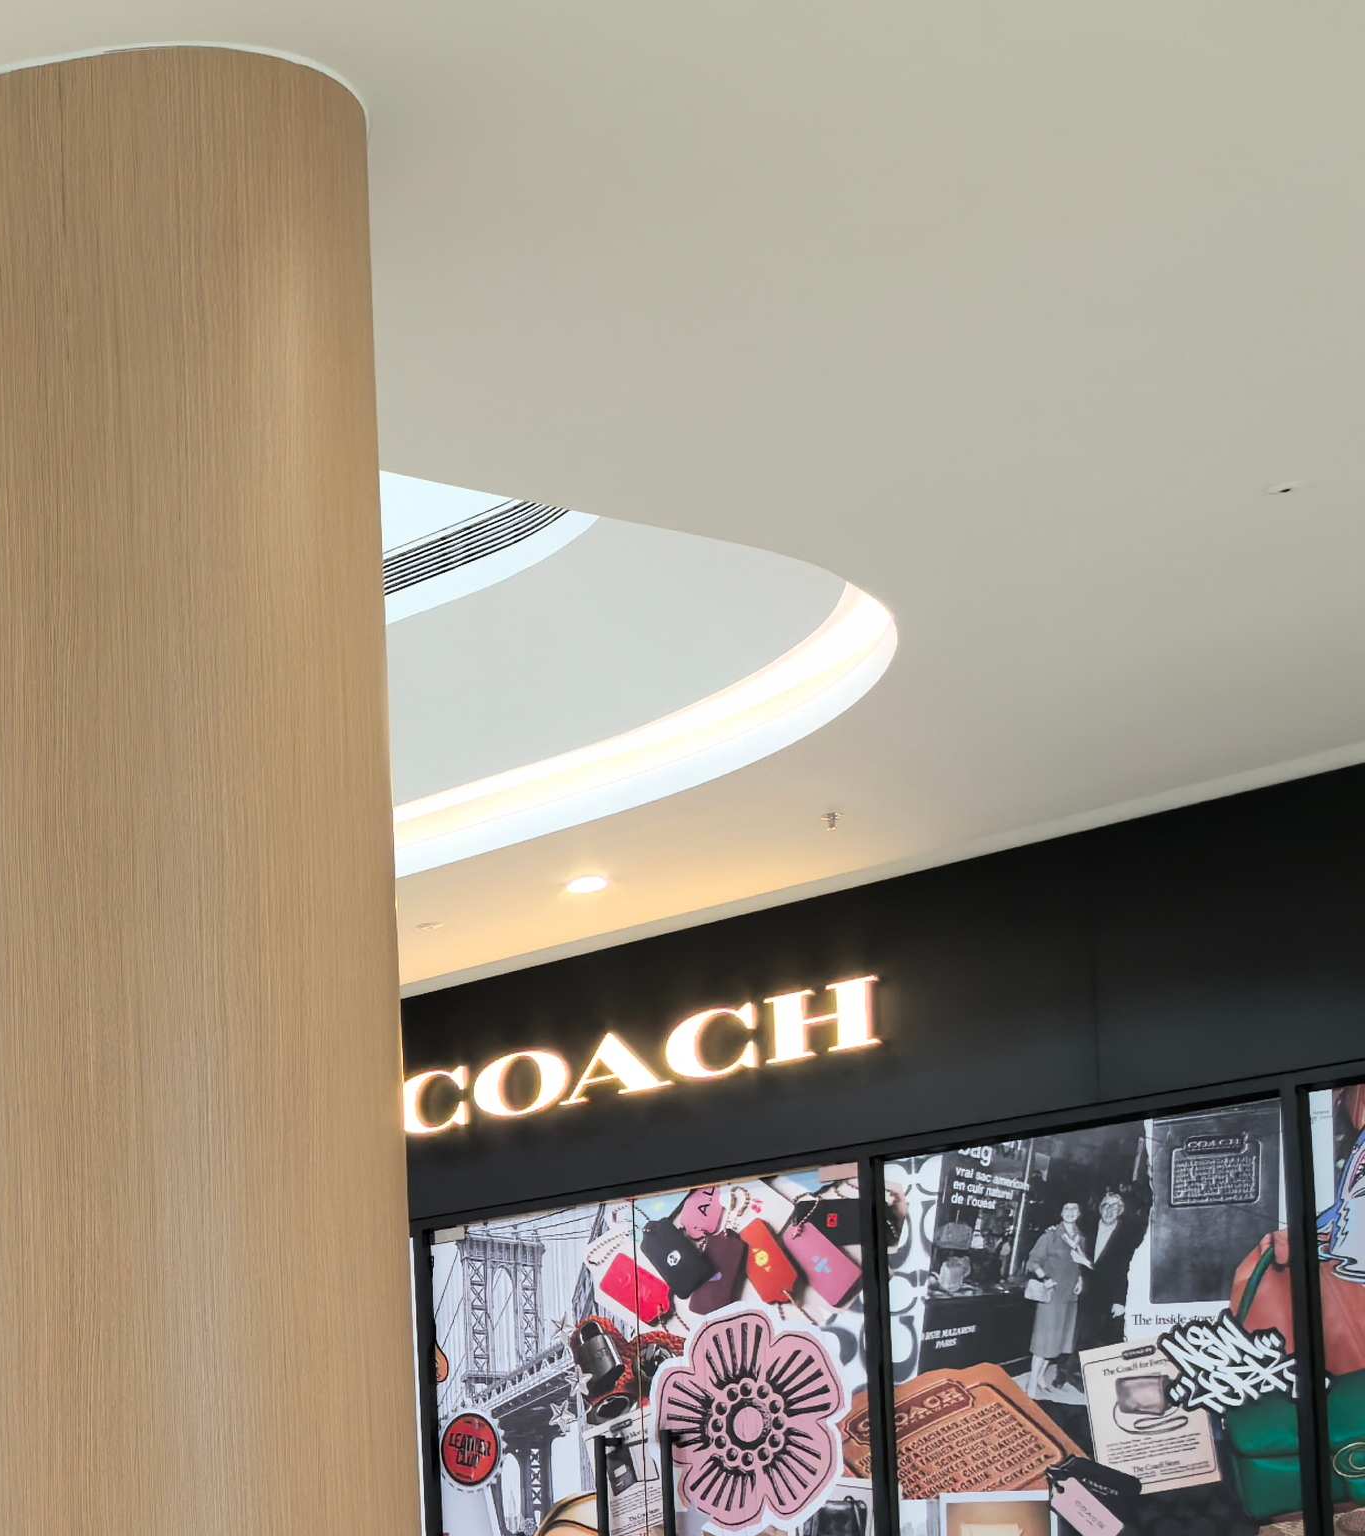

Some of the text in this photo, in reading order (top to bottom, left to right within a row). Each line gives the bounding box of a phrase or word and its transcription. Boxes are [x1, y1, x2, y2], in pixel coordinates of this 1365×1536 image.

[404, 974, 883, 1134] COACH
[955, 1166, 974, 1179] vrai
[975, 1171, 992, 1184] sac
[953, 1180, 966, 1191] en
[966, 1182, 985, 1195] cuir
[951, 1192, 964, 1204] de
[1132, 1314, 1151, 1326] The
[1155, 1313, 1188, 1325] inside
